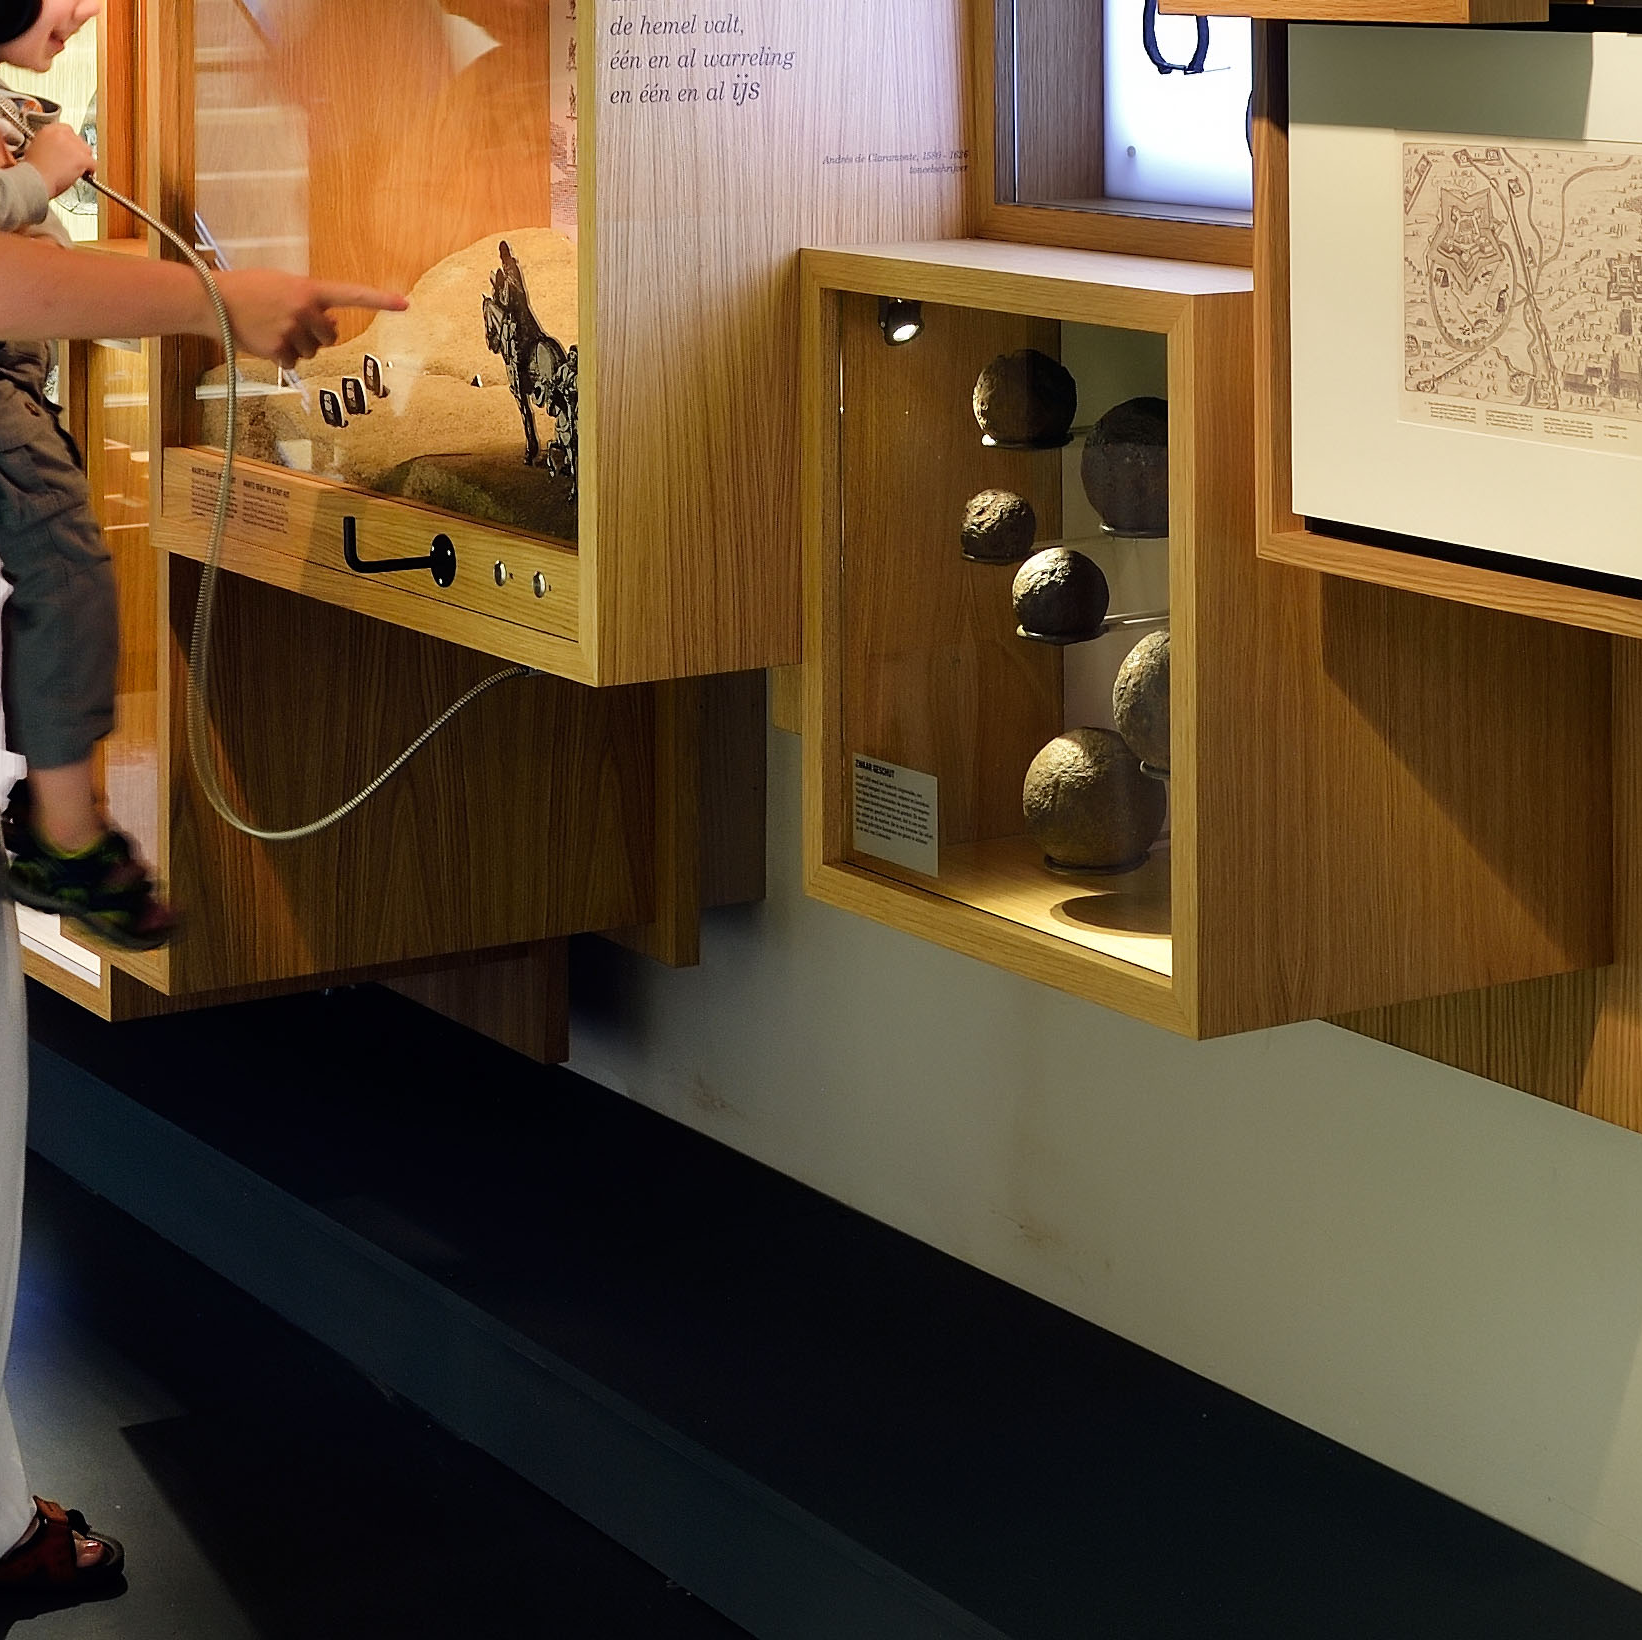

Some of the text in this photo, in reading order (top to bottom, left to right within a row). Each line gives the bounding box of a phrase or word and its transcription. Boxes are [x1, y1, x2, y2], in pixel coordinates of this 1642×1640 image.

[609, 13, 744, 36] de hemel valt,
[610, 46, 796, 70] één en al warreling
[610, 74, 761, 106] en één en al ijs
